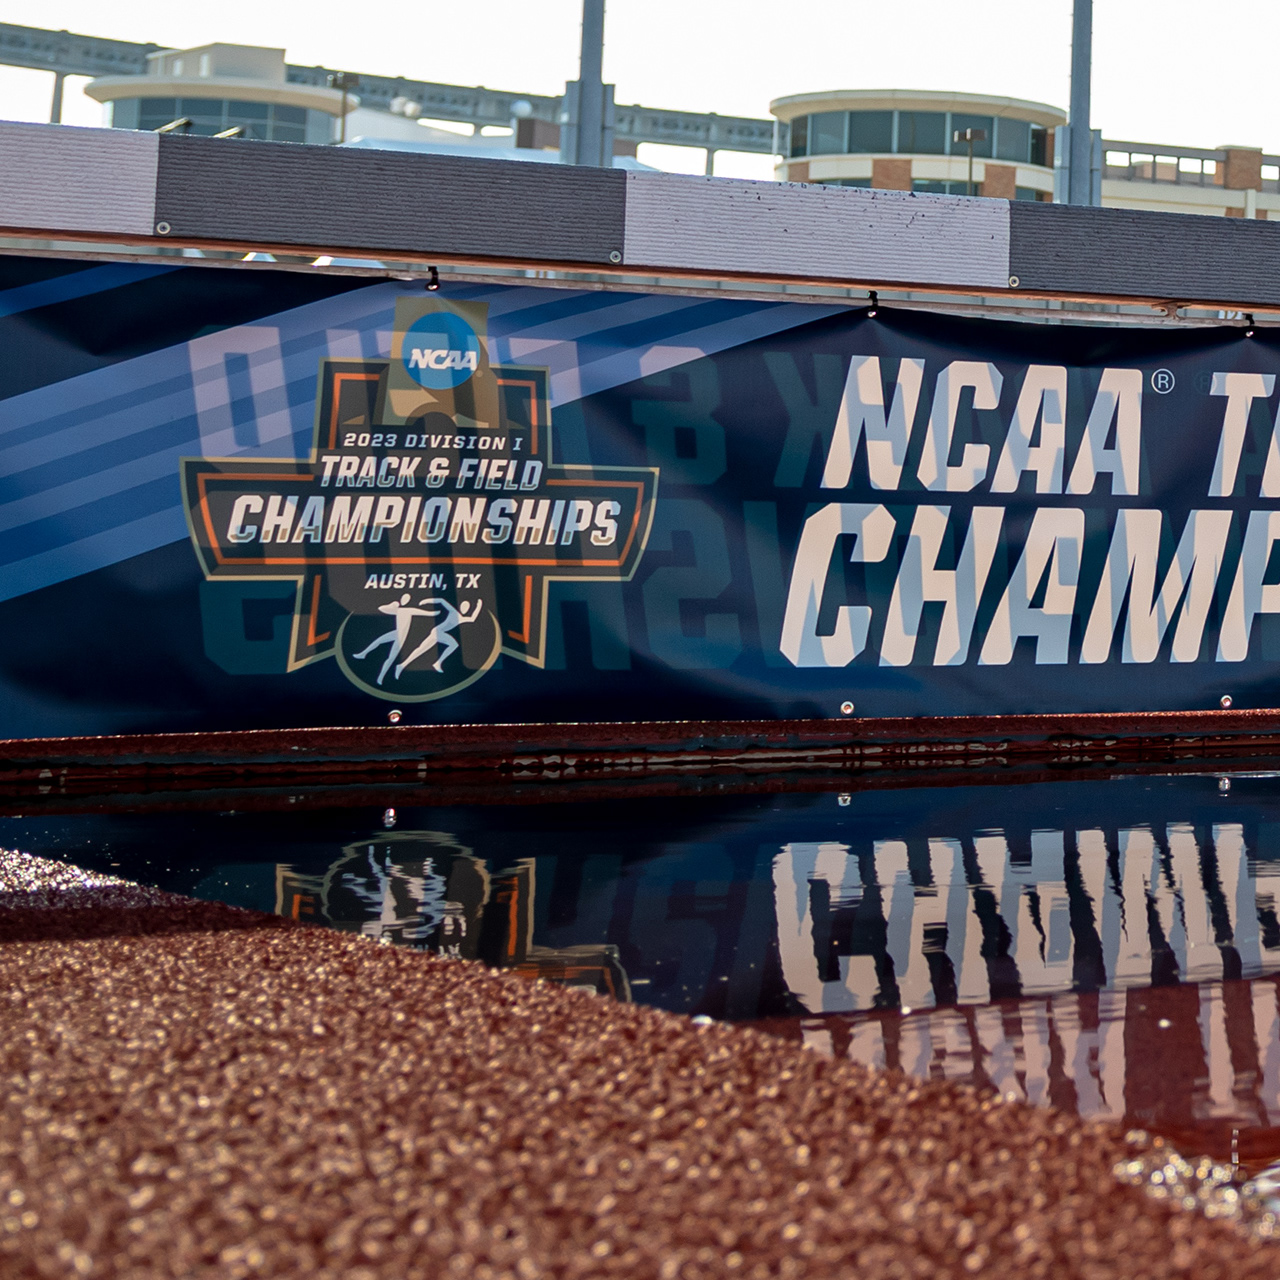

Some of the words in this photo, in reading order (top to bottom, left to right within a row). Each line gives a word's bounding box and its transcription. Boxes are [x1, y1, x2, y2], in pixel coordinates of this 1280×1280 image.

[408, 348, 478, 371] NCAA
[343, 432, 397, 448] 2023
[404, 435, 506, 450] DIVISION
[512, 437, 523, 451] I
[320, 456, 421, 487] TRACK
[425, 458, 450, 488] &
[455, 461, 543, 491] FIELD
[227, 495, 622, 545] CHAMPIONSHIPS
[365, 573, 449, 591] AUSTIN,
[455, 574, 481, 589] TX
